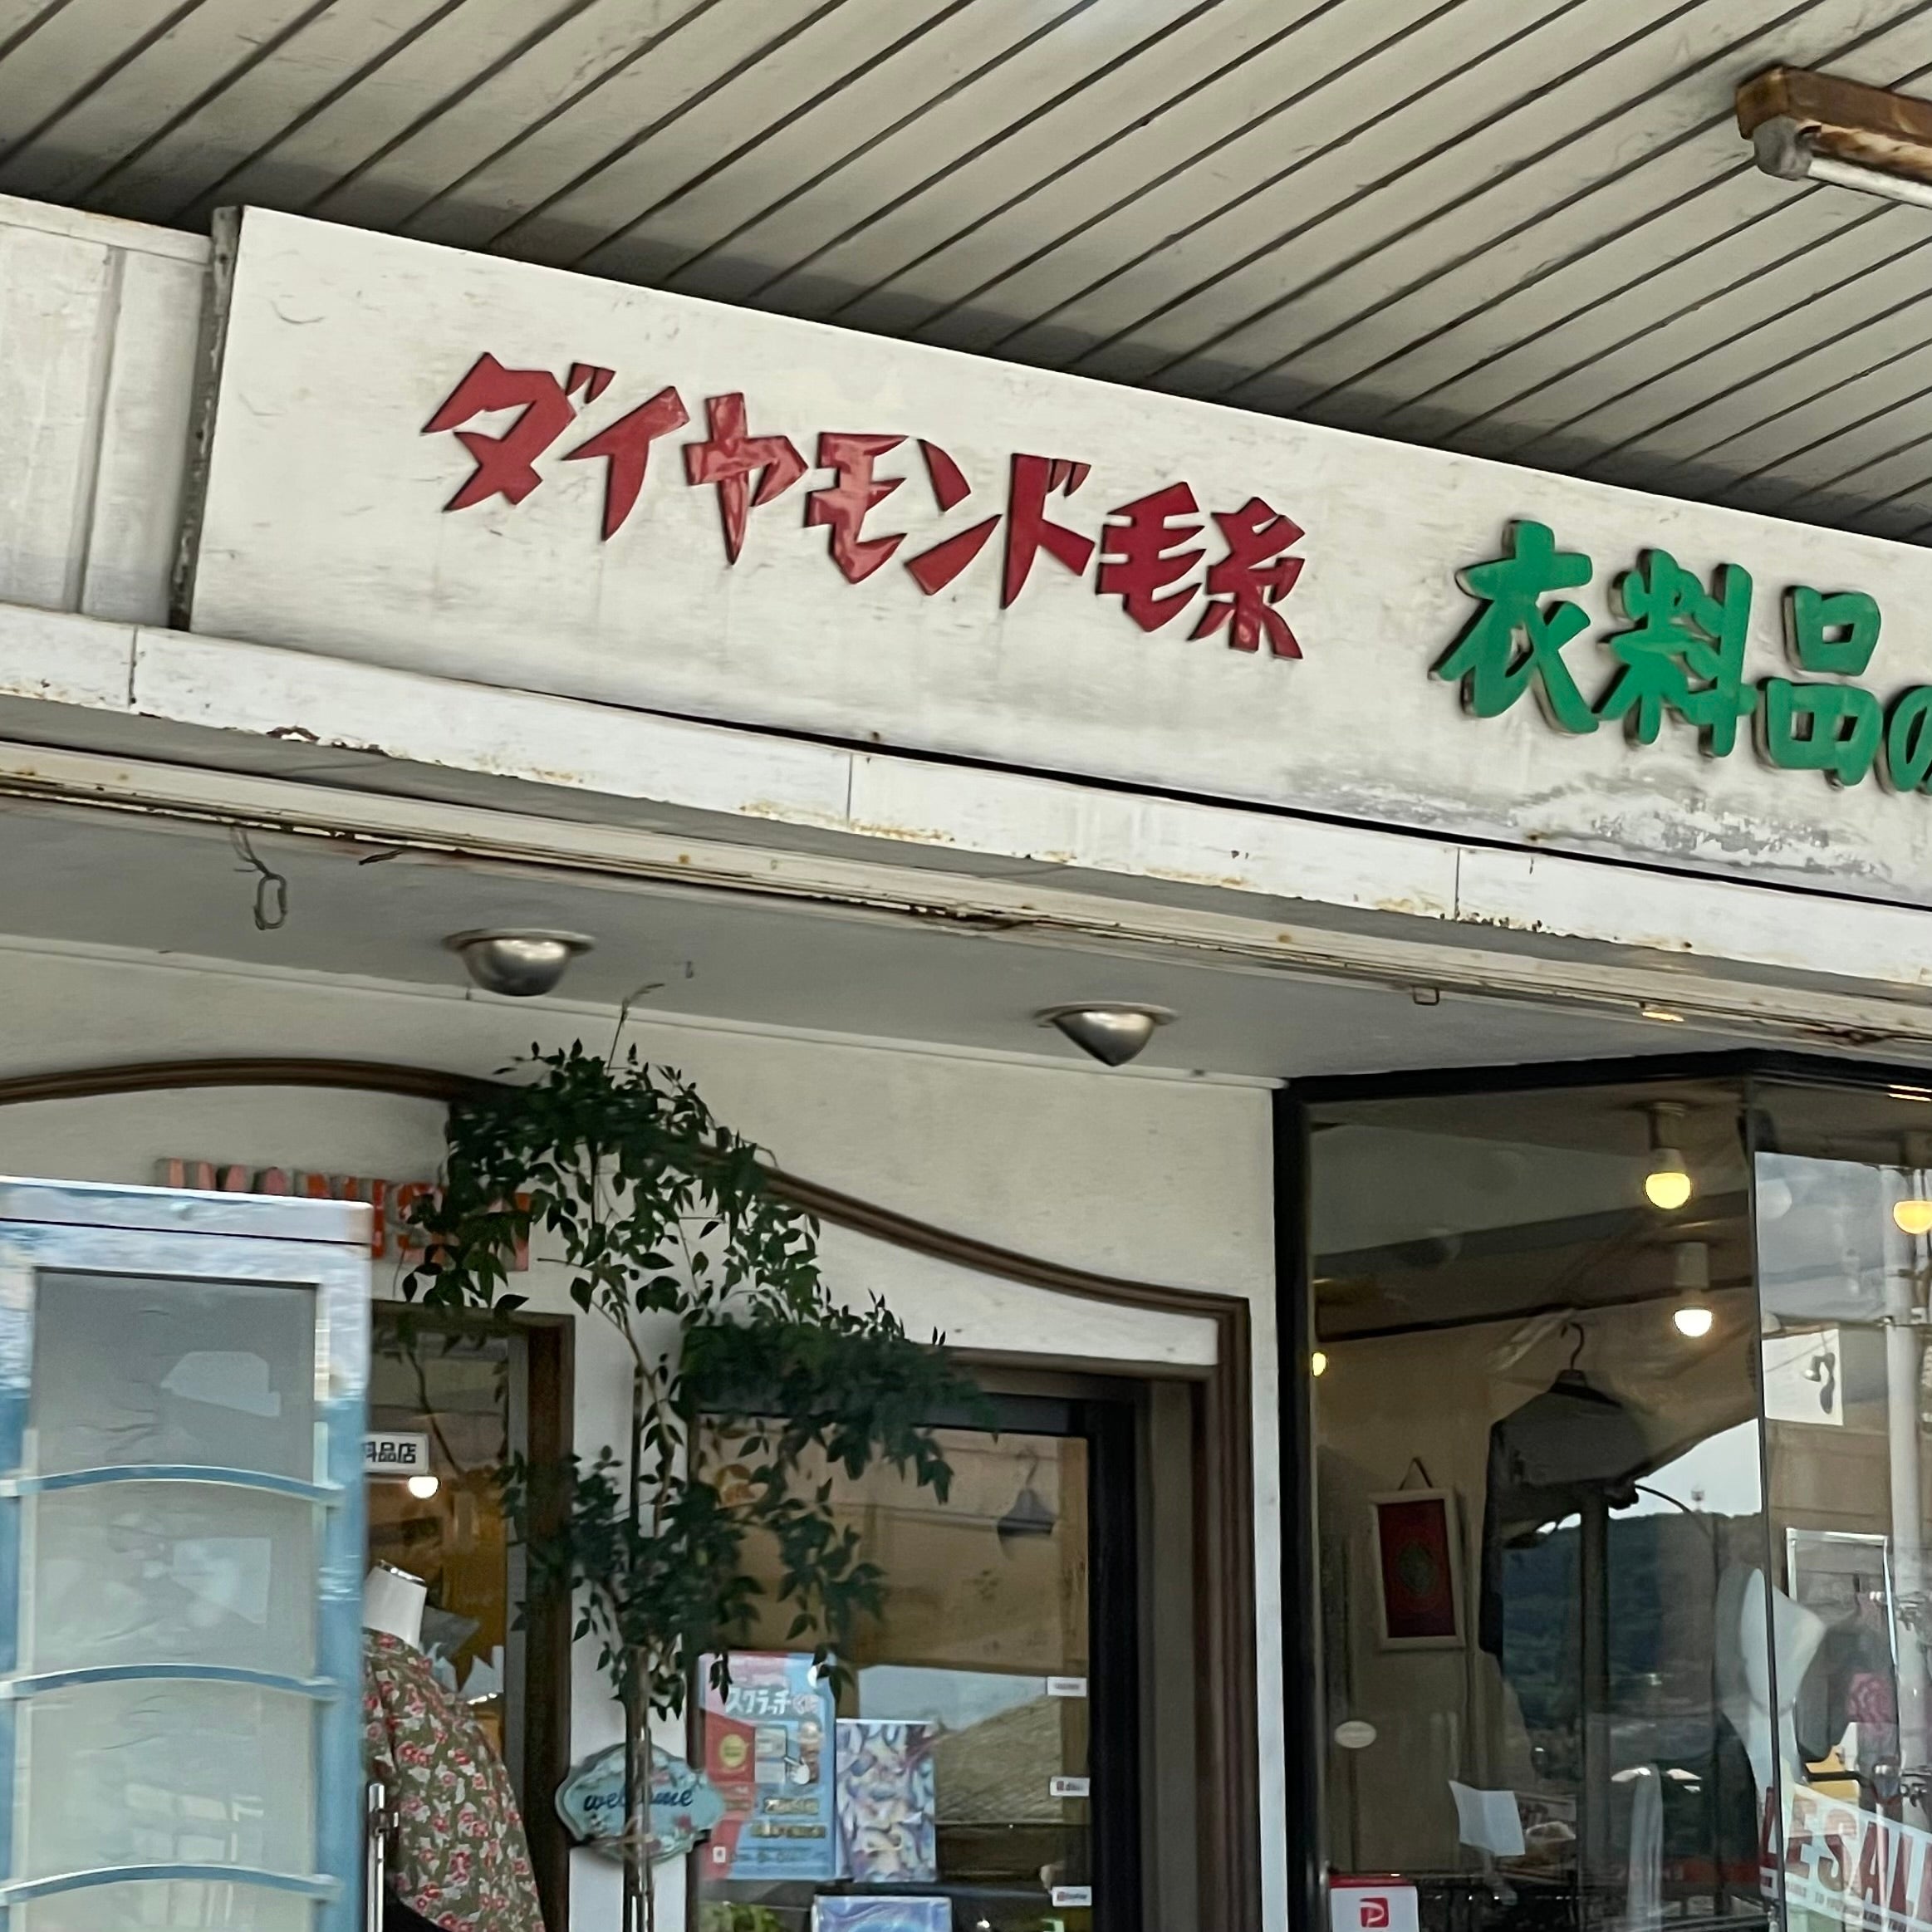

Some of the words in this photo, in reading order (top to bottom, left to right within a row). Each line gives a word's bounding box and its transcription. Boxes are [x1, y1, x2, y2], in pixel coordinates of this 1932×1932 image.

[422, 352, 1305, 659] ダイヤモンド毛糸
[583, 1788, 694, 1812] weme
